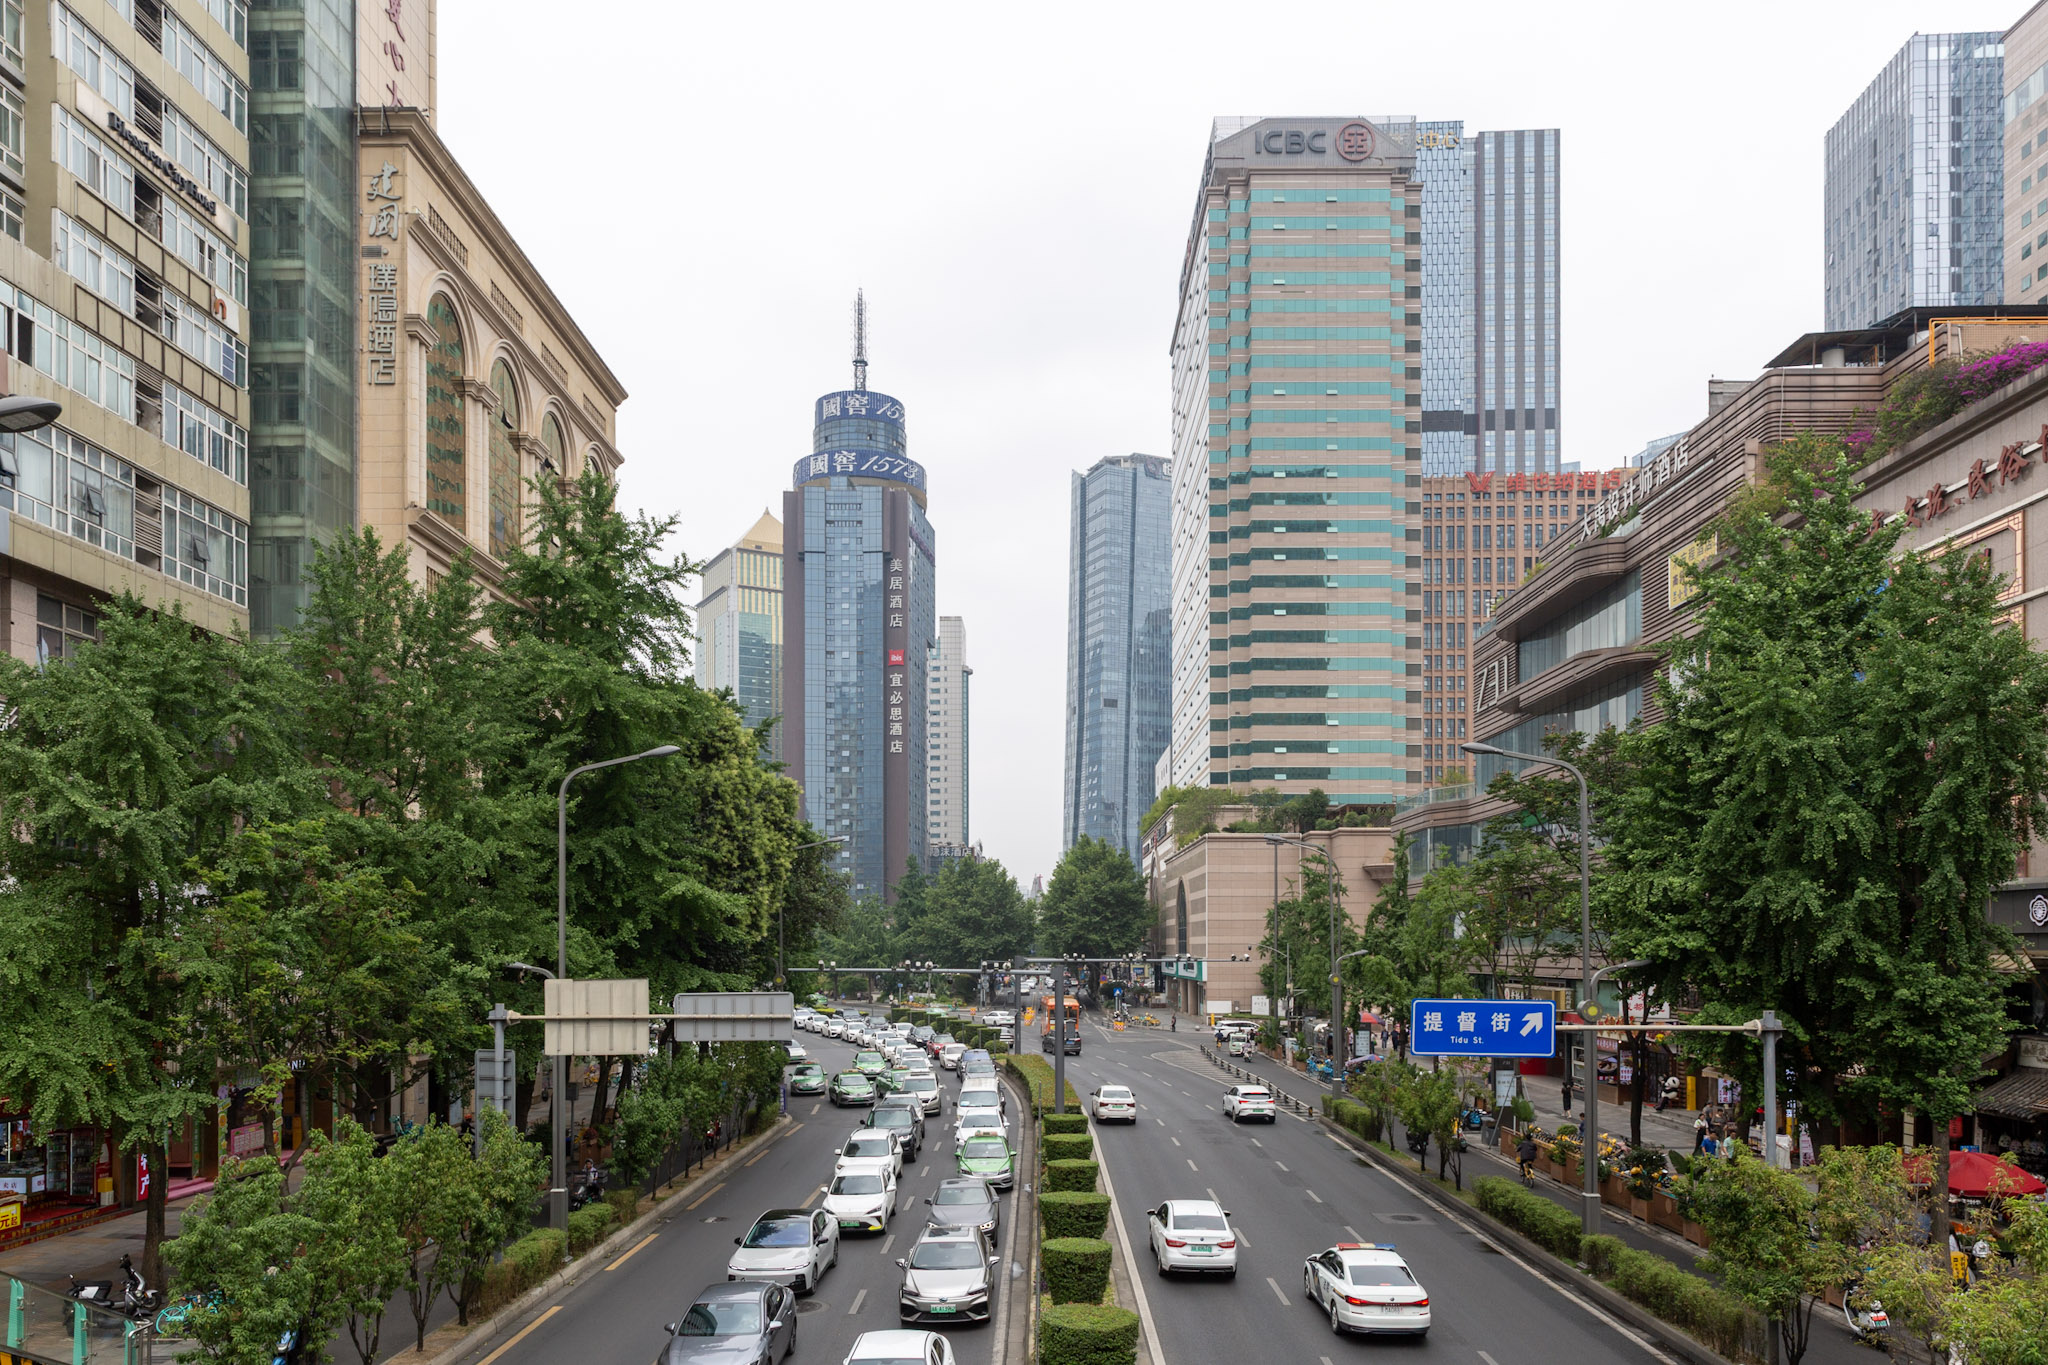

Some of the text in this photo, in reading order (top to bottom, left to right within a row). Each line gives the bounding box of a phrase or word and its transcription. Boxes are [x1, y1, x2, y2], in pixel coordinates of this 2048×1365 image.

[1255, 130, 1327, 154] ICBC
[161, 161, 188, 191] City
[185, 180, 216, 216] Hotel
[1506, 470, 1621, 491] 维也纳酒店
[1580, 436, 1689, 541] 大禹设计师酒店
[889, 558, 904, 628] 美居酒店
[891, 654, 902, 662] ibis
[889, 673, 904, 754] 宜必思酒店
[1423, 1011, 1512, 1033] 提督街
[1450, 1035, 1484, 1044] Tidu St.
